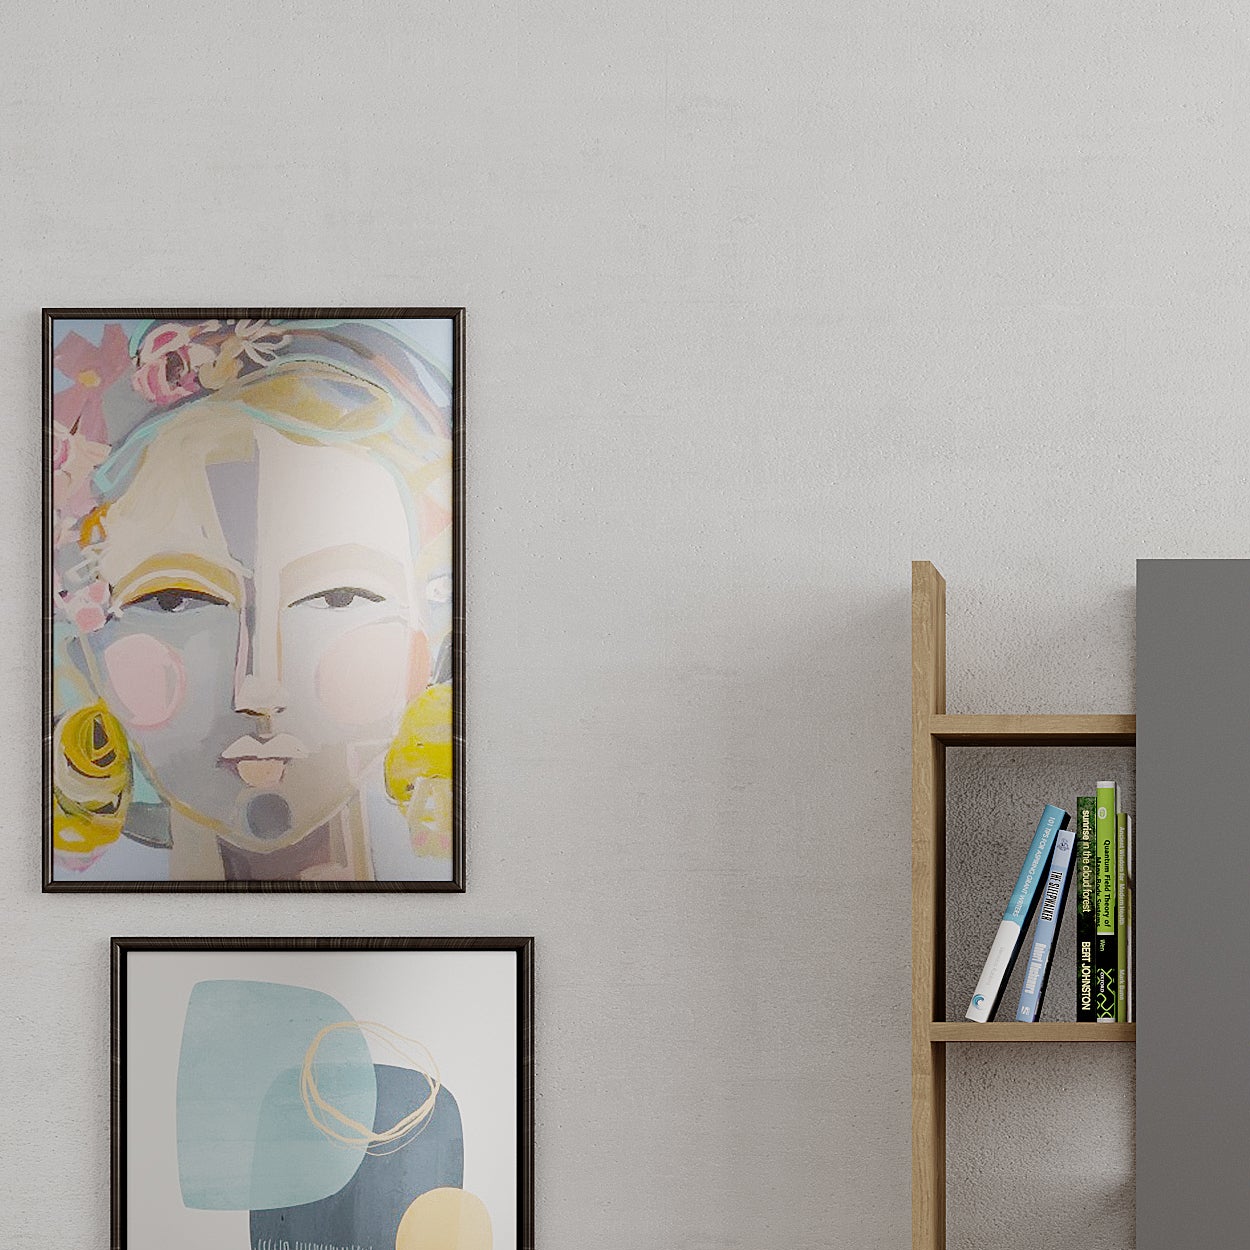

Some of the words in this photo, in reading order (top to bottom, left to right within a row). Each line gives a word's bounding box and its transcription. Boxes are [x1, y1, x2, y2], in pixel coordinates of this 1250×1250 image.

[1047, 817, 1055, 825] 101
[1083, 810, 1092, 839] sunrise
[1038, 838, 1048, 849] FOR
[1043, 828, 1052, 838] TIPS
[1028, 850, 1042, 875] ASPIRING
[1083, 851, 1092, 863] the
[1021, 875, 1033, 894] GRANT
[1049, 871, 1063, 882] THE
[1083, 865, 1092, 887] cloud
[1012, 895, 1024, 918] WRITERS
[1041, 882, 1059, 921] SLEEPWALKER
[1083, 889, 1092, 912] forest
[1082, 942, 1090, 962] BERT
[1082, 963, 1090, 1010] JOHNSTON
